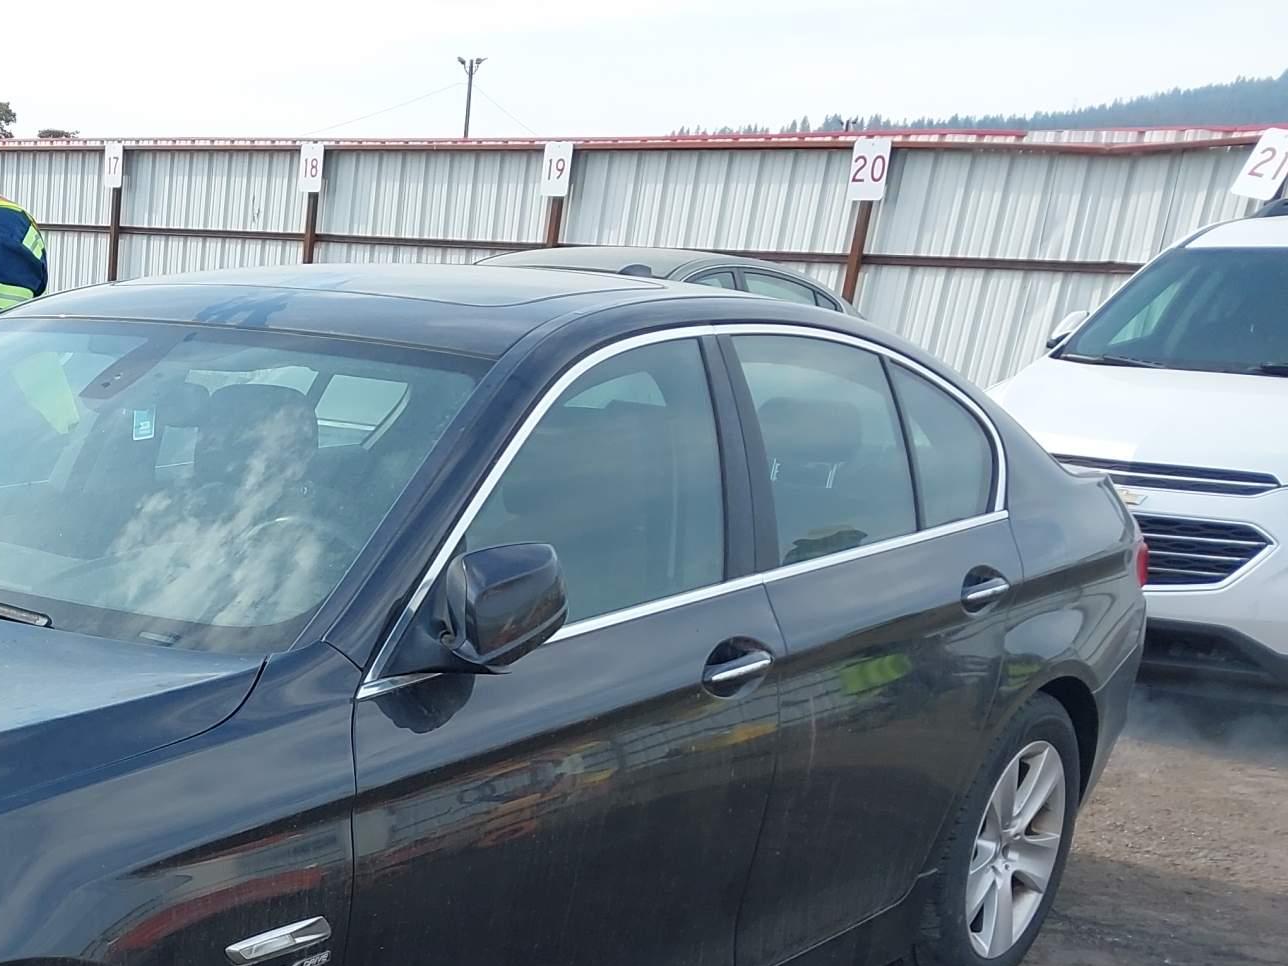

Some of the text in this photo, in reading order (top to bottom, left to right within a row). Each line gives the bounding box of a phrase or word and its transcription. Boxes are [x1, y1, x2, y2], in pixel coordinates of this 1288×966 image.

[108, 156, 119, 175] 17
[304, 158, 318, 178] 18
[547, 158, 565, 180] 19
[851, 154, 886, 182] 20
[1247, 146, 1288, 180] 21
